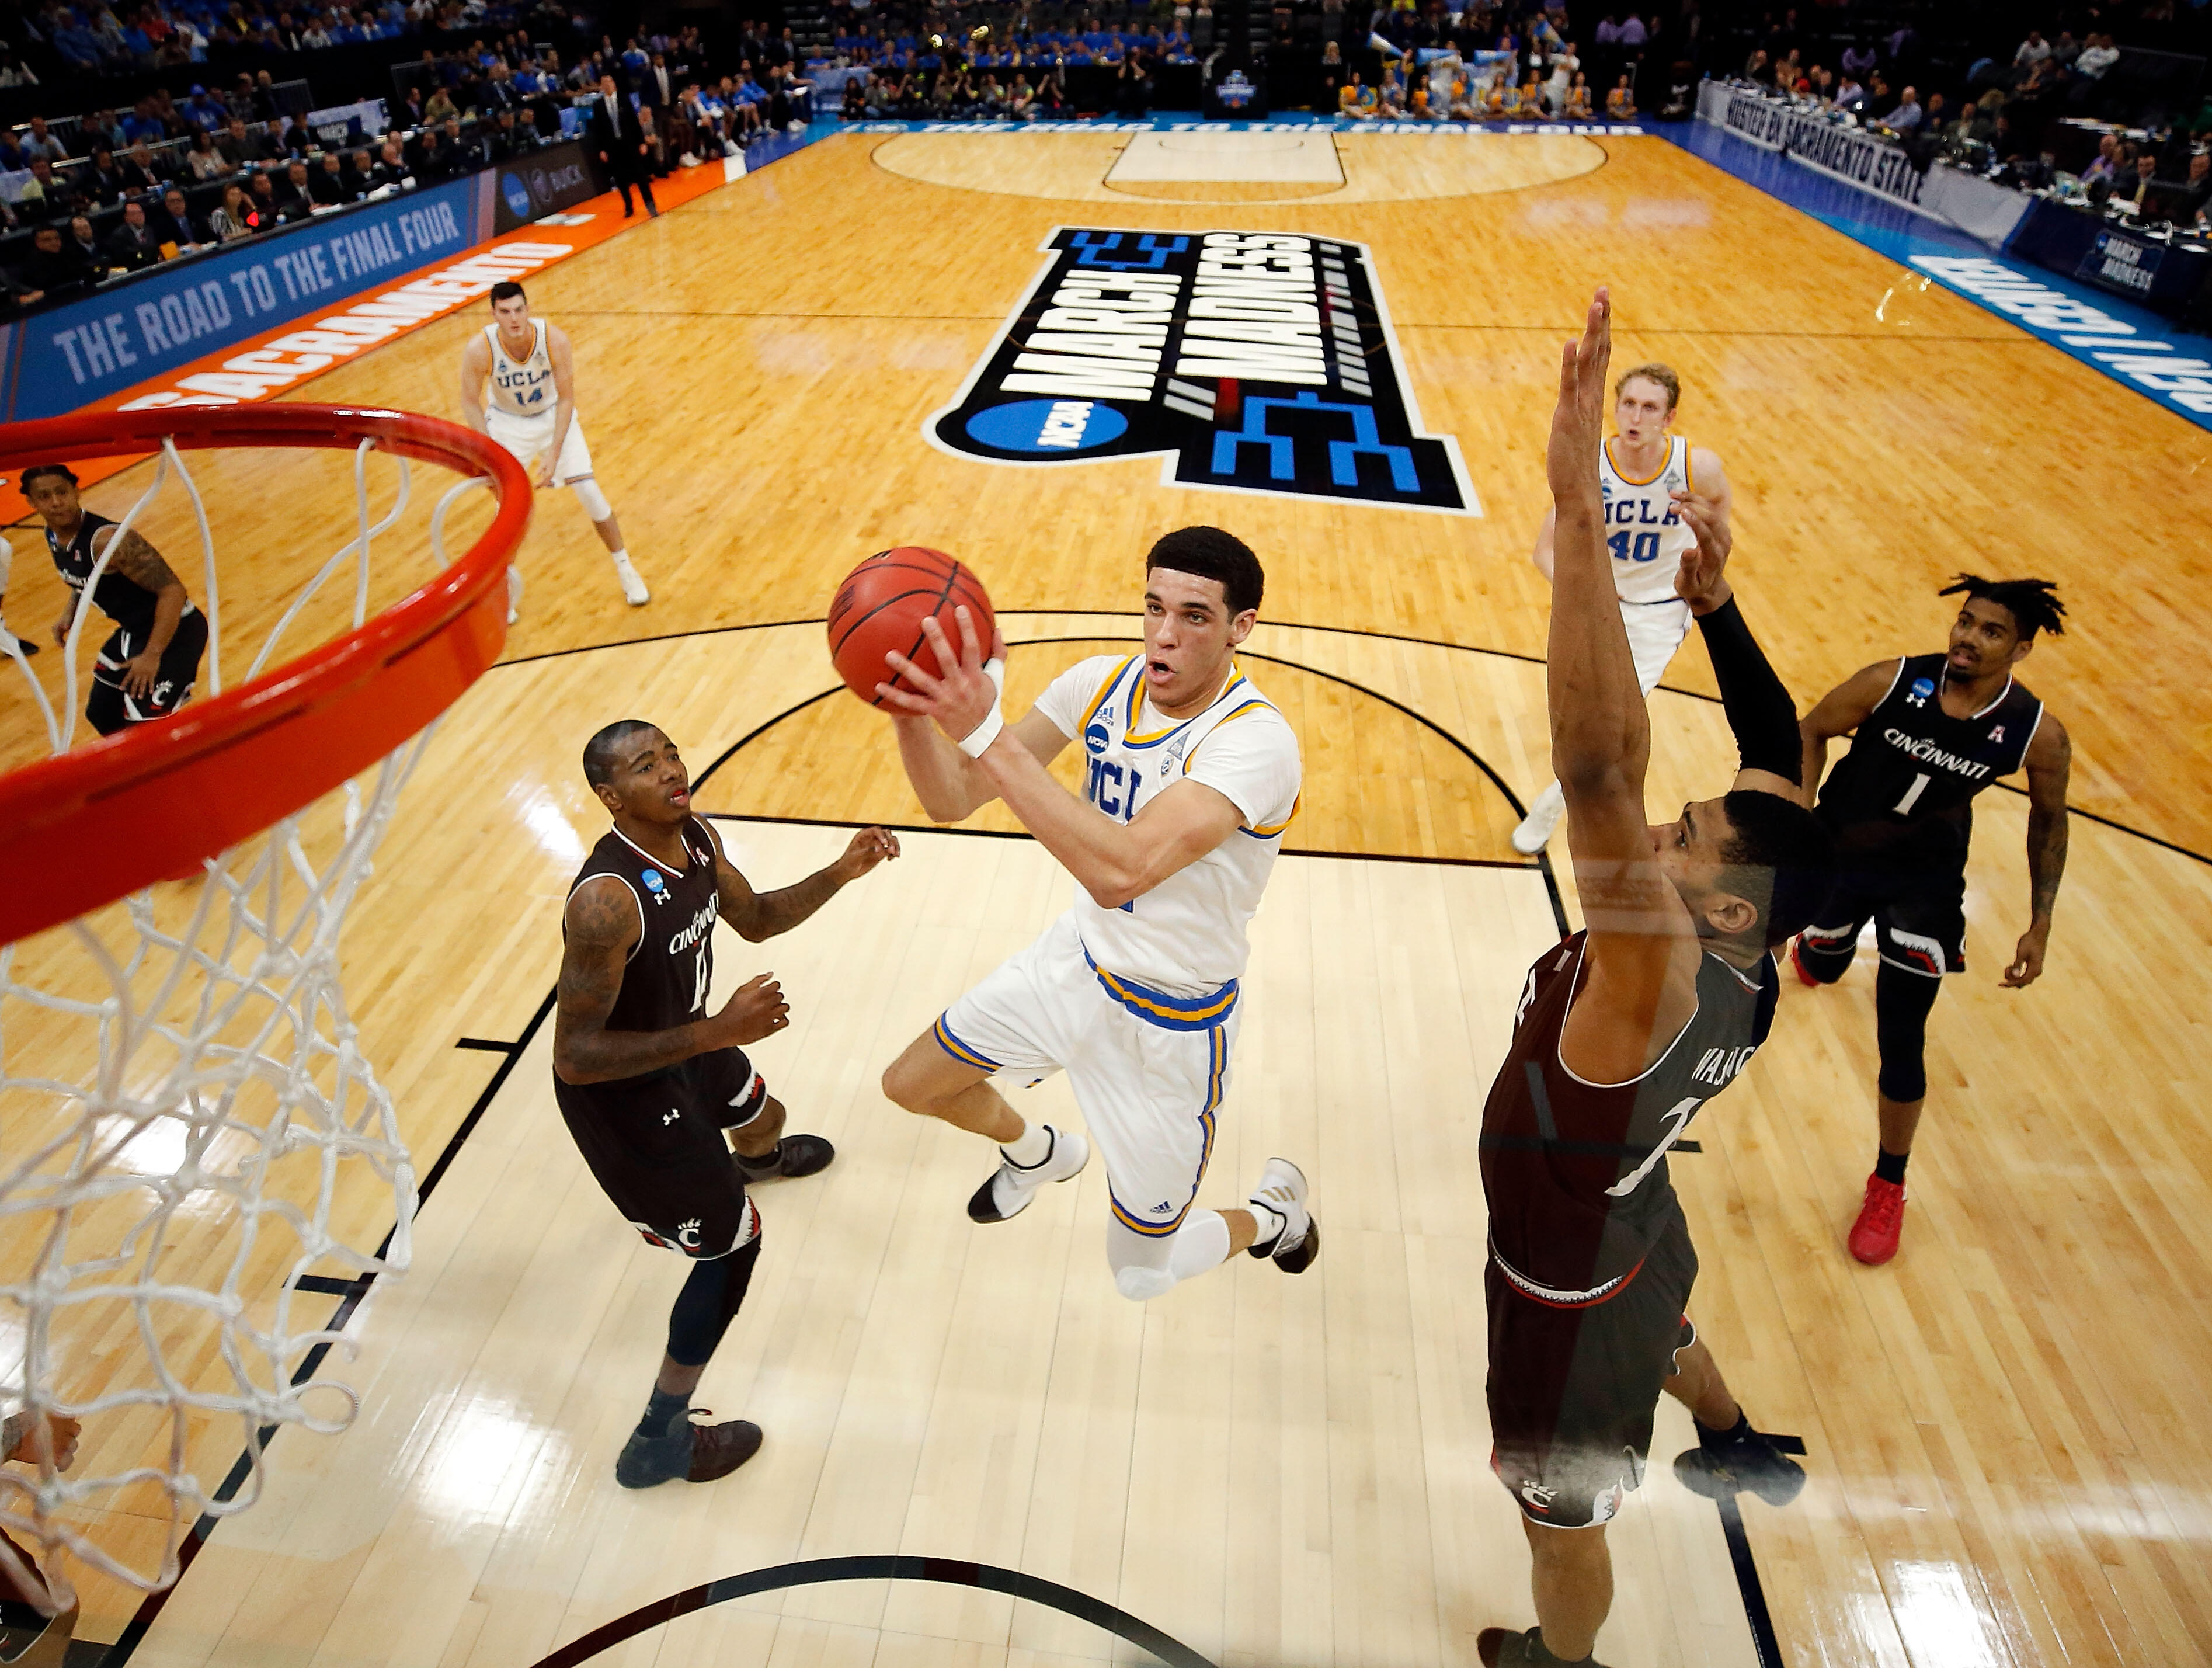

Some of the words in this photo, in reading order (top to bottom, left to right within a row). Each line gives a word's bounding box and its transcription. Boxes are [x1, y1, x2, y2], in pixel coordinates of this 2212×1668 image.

[1018, 123, 1154, 132] ROAD
[1170, 123, 1230, 132] TO
[1248, 123, 1338, 132] THE
[1351, 123, 1490, 133] FINAL
[1507, 124, 1643, 135] FOUR
[1785, 117, 1874, 182] SACRAMENTO
[53, 314, 138, 385] THE
[135, 279, 232, 354] ROAD
[231, 269, 277, 317] TO
[274, 245, 335, 302] THE
[329, 224, 404, 283] FINAL
[397, 200, 460, 255] FOUR
[1175, 233, 1328, 385] MADNESS
[999, 269, 1182, 401] MARCH
[498, 369, 550, 388] UCLA
[514, 388, 542, 406] 14
[1037, 401, 1094, 449] NCAA
[1607, 530, 1661, 562] 40
[1883, 728, 1991, 780] CINCINNATI
[1893, 772, 1931, 816] 1
